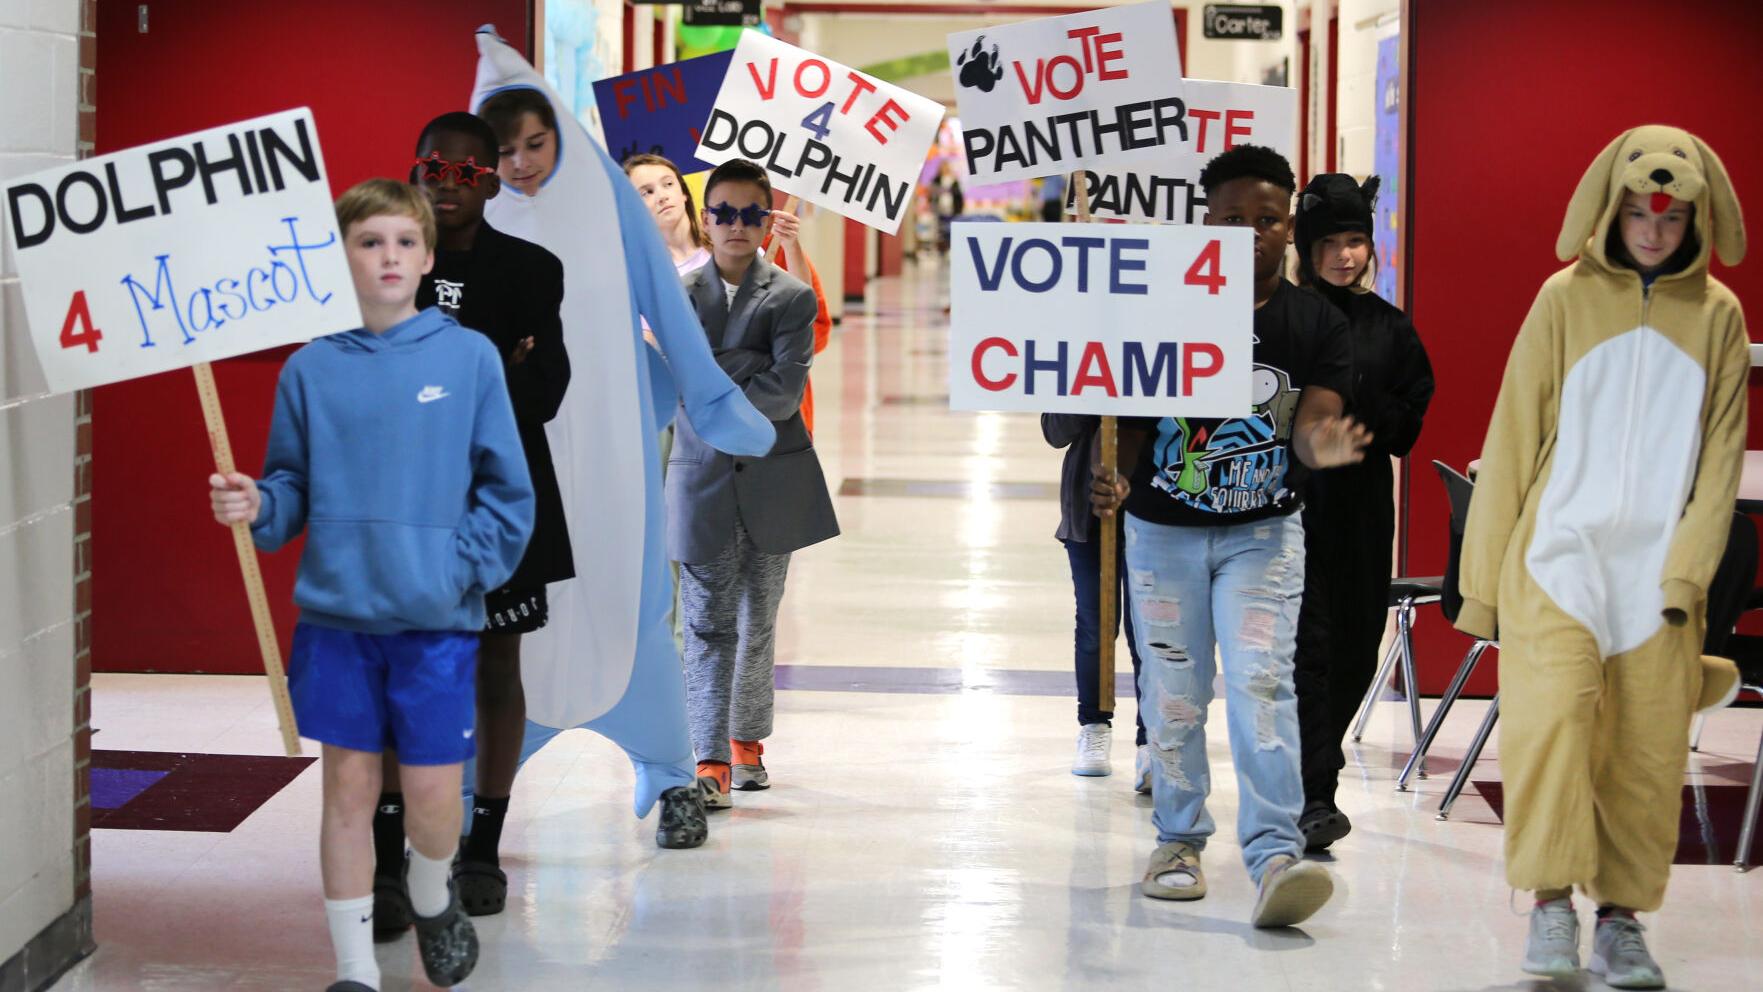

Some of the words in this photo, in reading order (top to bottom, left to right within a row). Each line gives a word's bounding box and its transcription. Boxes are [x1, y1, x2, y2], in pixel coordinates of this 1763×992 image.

[613, 68, 688, 121] FIN
[1012, 26, 1129, 105] VOTE
[746, 57, 910, 145] VOTE
[800, 101, 836, 142] 4
[1188, 108, 1255, 153] TE
[701, 108, 909, 221] DOLPHIN
[962, 97, 1189, 176] PANTHER
[7, 118, 320, 250] DOLPHIN
[59, 289, 103, 354] 4
[120, 216, 336, 348] Mascot
[967, 236, 1150, 295] VOTE
[1184, 240, 1227, 295] 4
[971, 336, 1225, 398] CHAMP
[1228, 460, 1252, 488] ME
